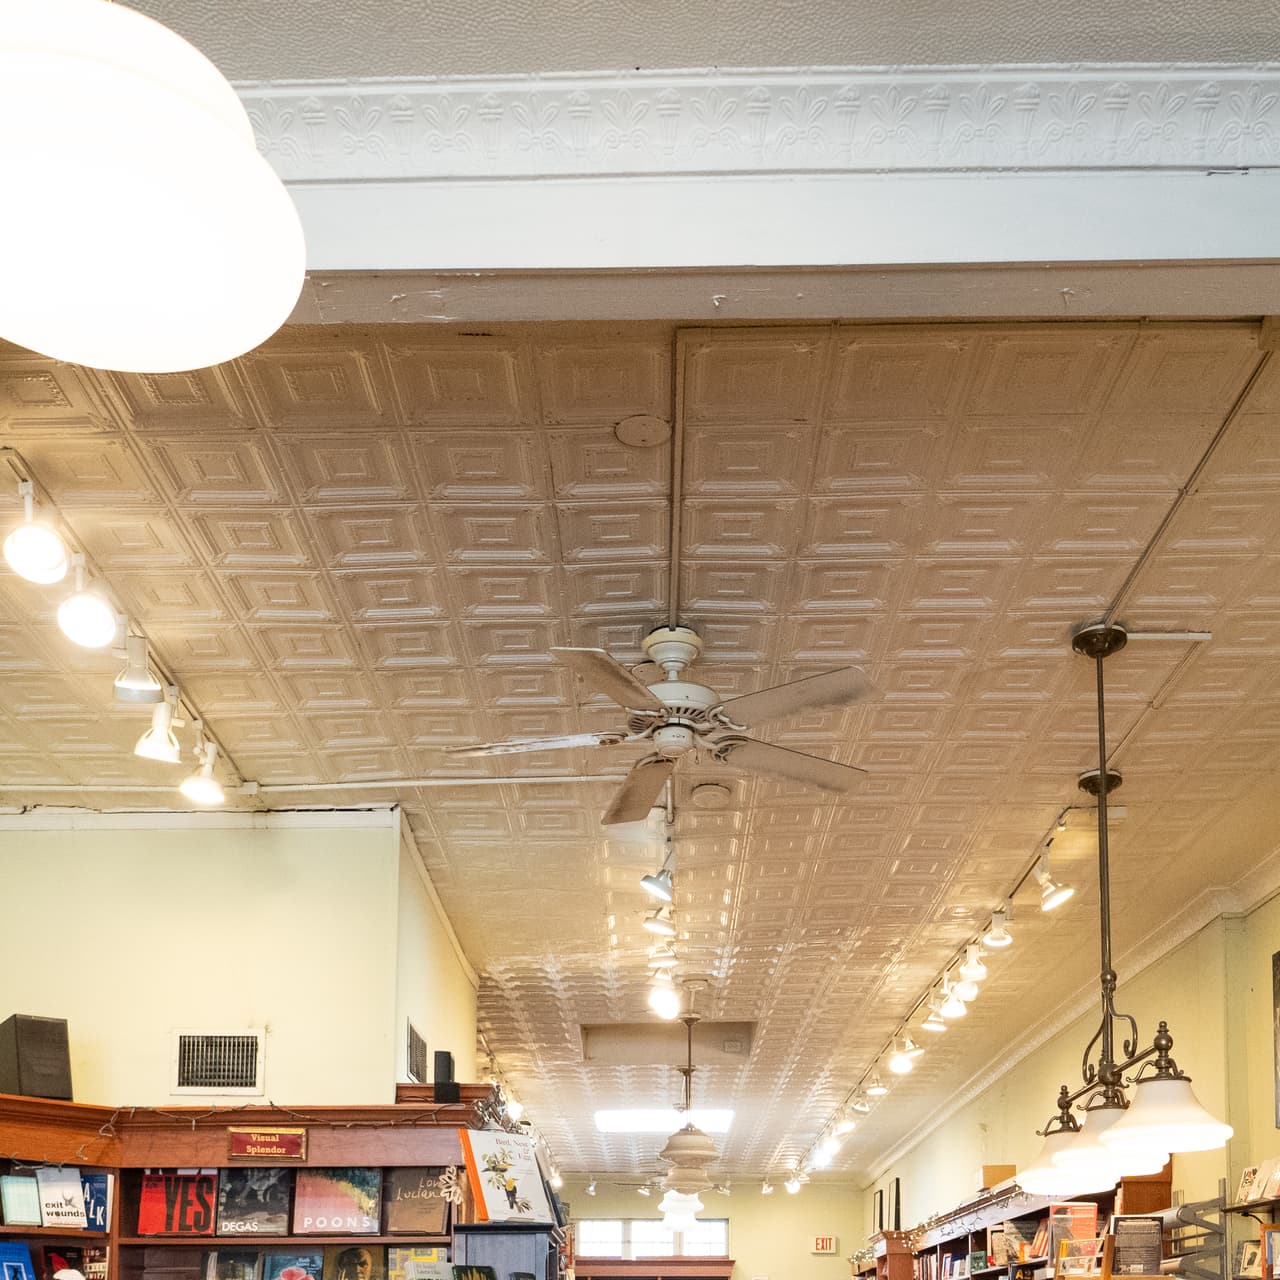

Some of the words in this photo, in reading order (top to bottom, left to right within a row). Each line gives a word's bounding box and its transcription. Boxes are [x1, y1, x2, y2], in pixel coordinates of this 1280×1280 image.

[251, 1134, 280, 1142] Visual
[247, 1145, 286, 1155] Splendor
[164, 1175, 213, 1232] YES
[46, 1210, 84, 1218] wounds
[222, 1222, 258, 1232] DEGAS
[303, 1217, 370, 1228] POONS
[816, 1237, 833, 1251] EXIT
